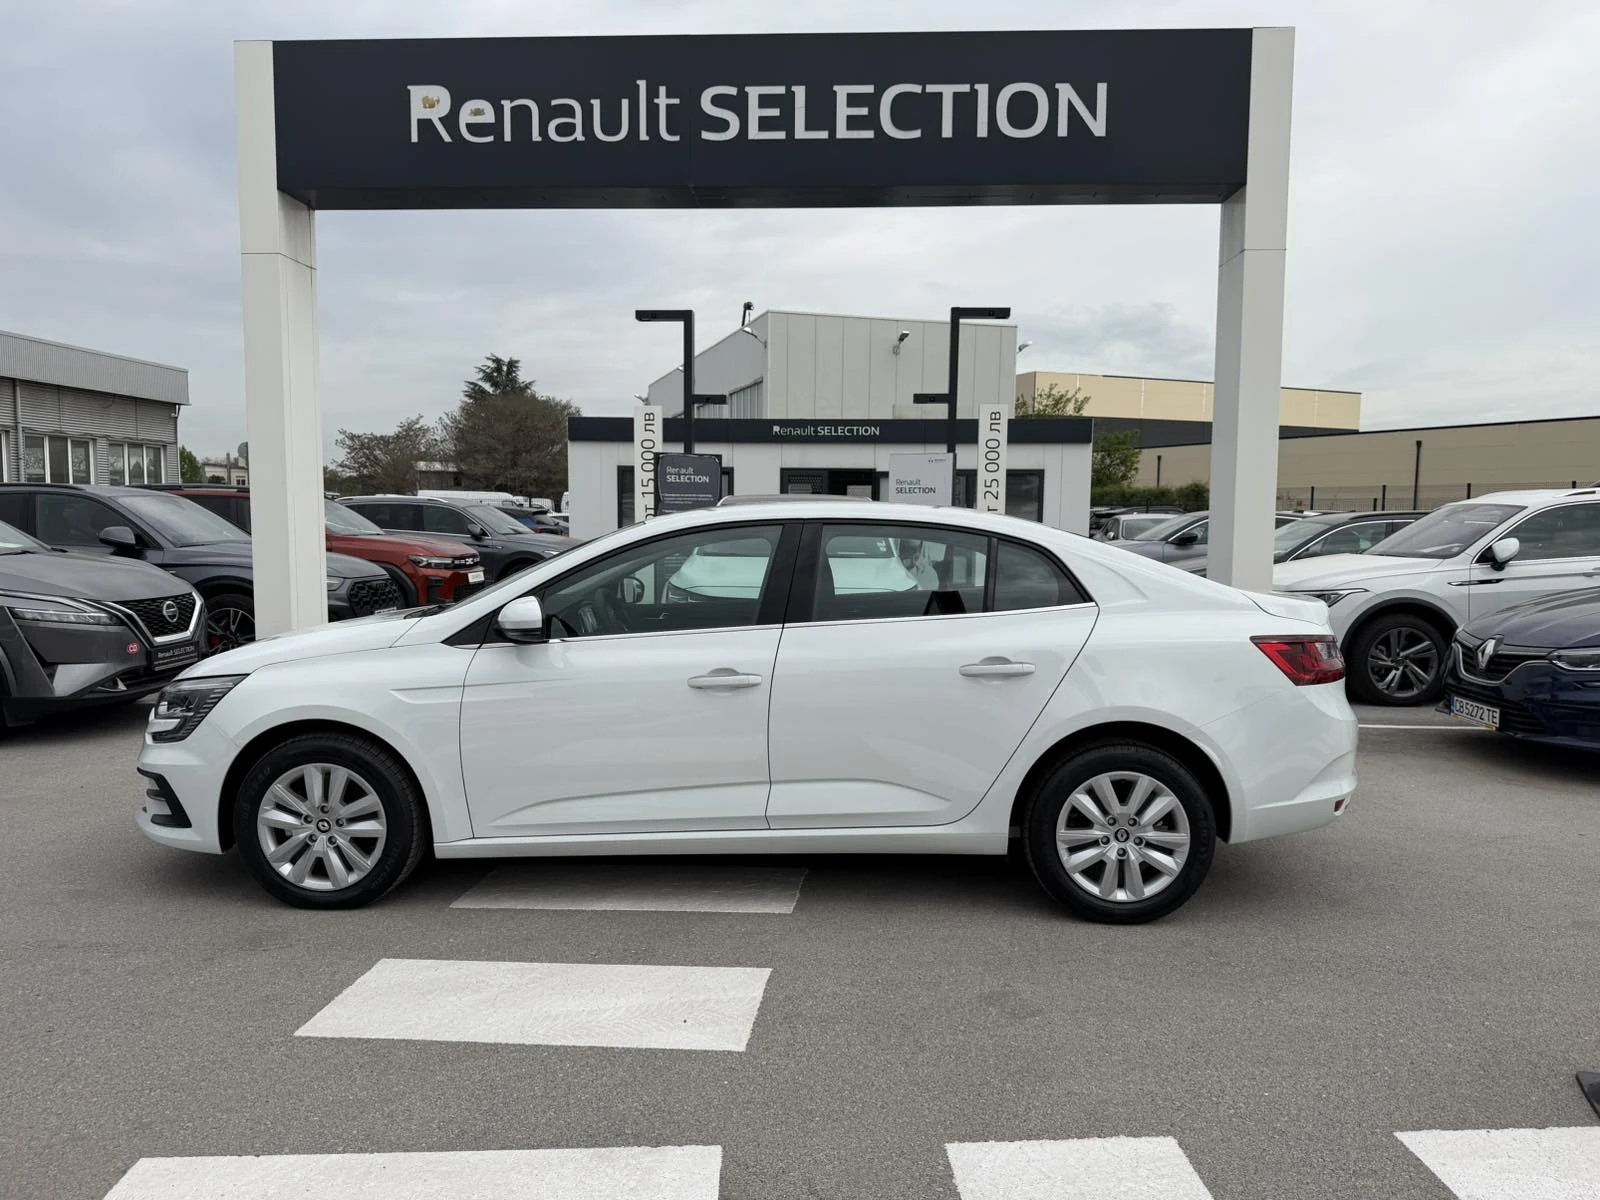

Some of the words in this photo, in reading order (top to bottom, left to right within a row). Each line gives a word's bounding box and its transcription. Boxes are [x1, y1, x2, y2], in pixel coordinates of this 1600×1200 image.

[407, 79, 681, 143] Renault
[700, 82, 1108, 141] SELECTION
[772, 425, 815, 436] Renault
[817, 425, 880, 436] SELECTION
[641, 439, 655, 473] 000
[985, 438, 1000, 473] 000
[666, 466, 694, 474] Renault
[666, 475, 710, 483] SELECTION
[896, 478, 921, 486] Renault
[642, 479, 655, 497] 15
[896, 486, 936, 494] SELECTION
[983, 478, 999, 500] 25
